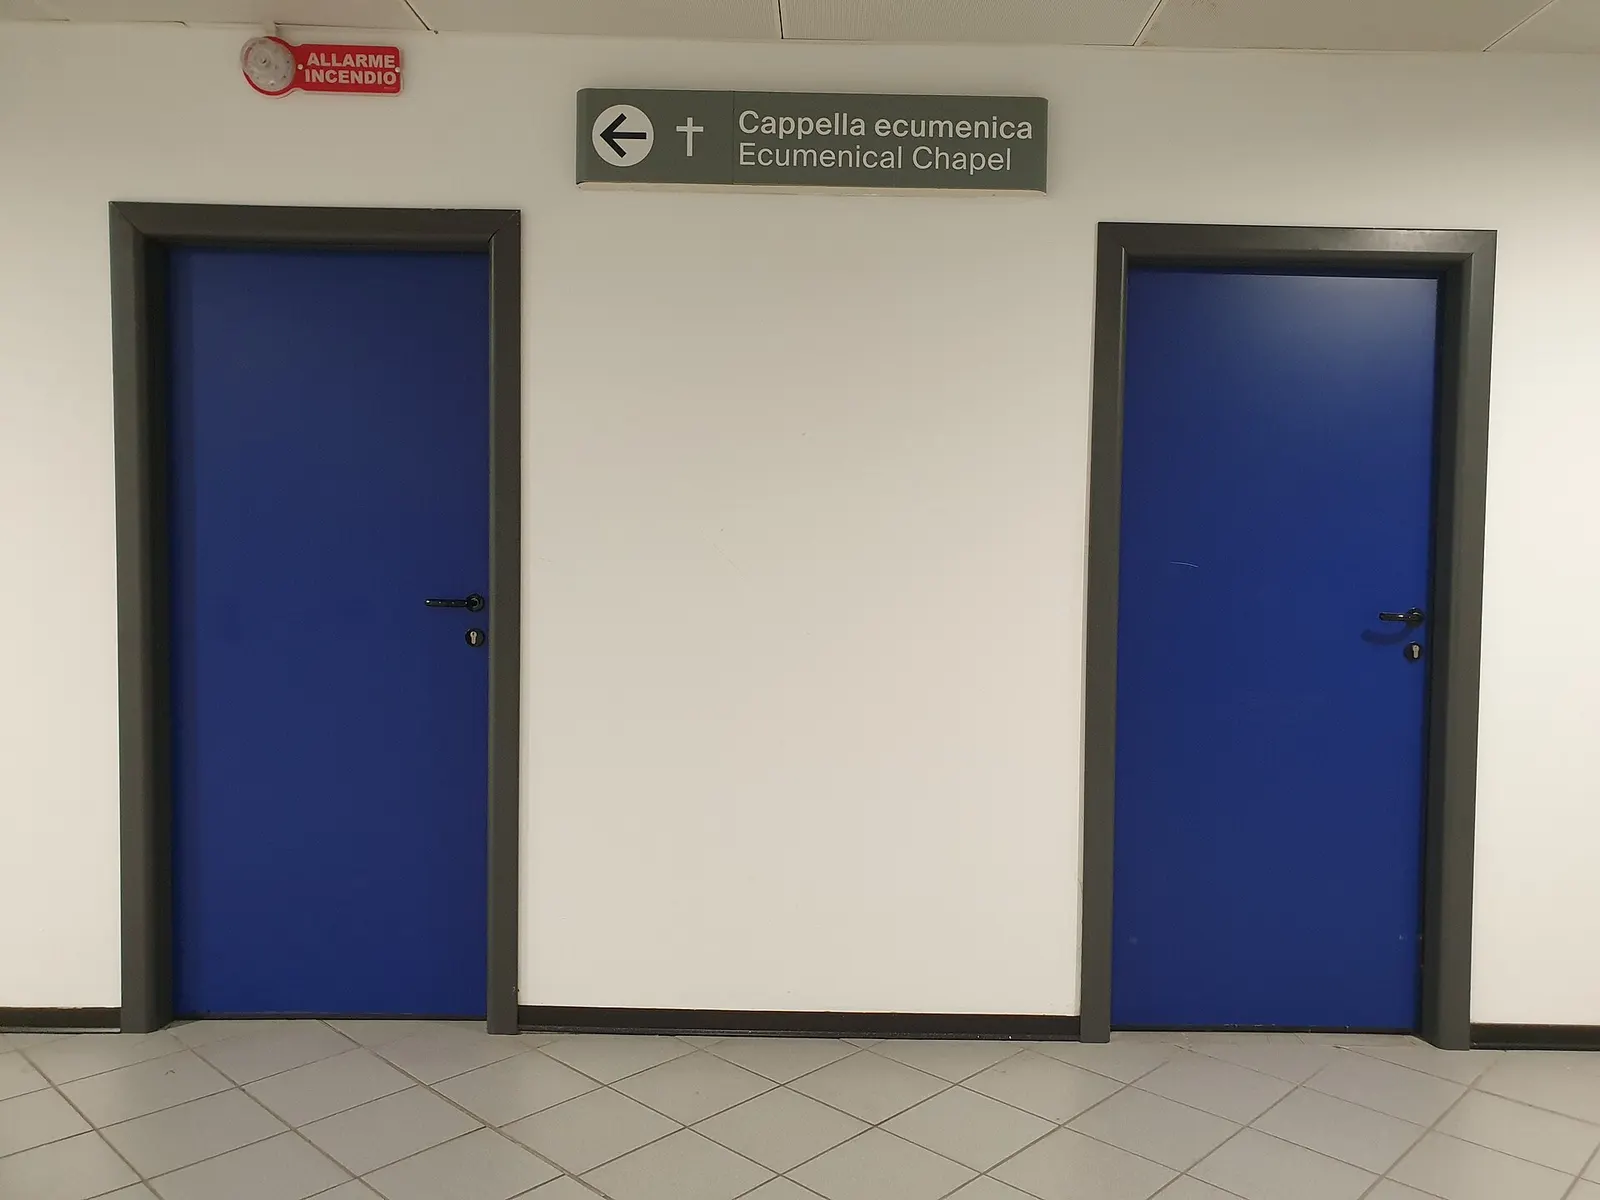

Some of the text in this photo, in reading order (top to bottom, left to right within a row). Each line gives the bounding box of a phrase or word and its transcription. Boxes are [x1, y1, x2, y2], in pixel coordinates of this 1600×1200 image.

[306, 52, 396, 69] ALLARME
[304, 69, 397, 85] INCENDIO
[738, 110, 1034, 140] Cappella ecumenica
[739, 142, 1012, 176] Ecumenical Chapel
